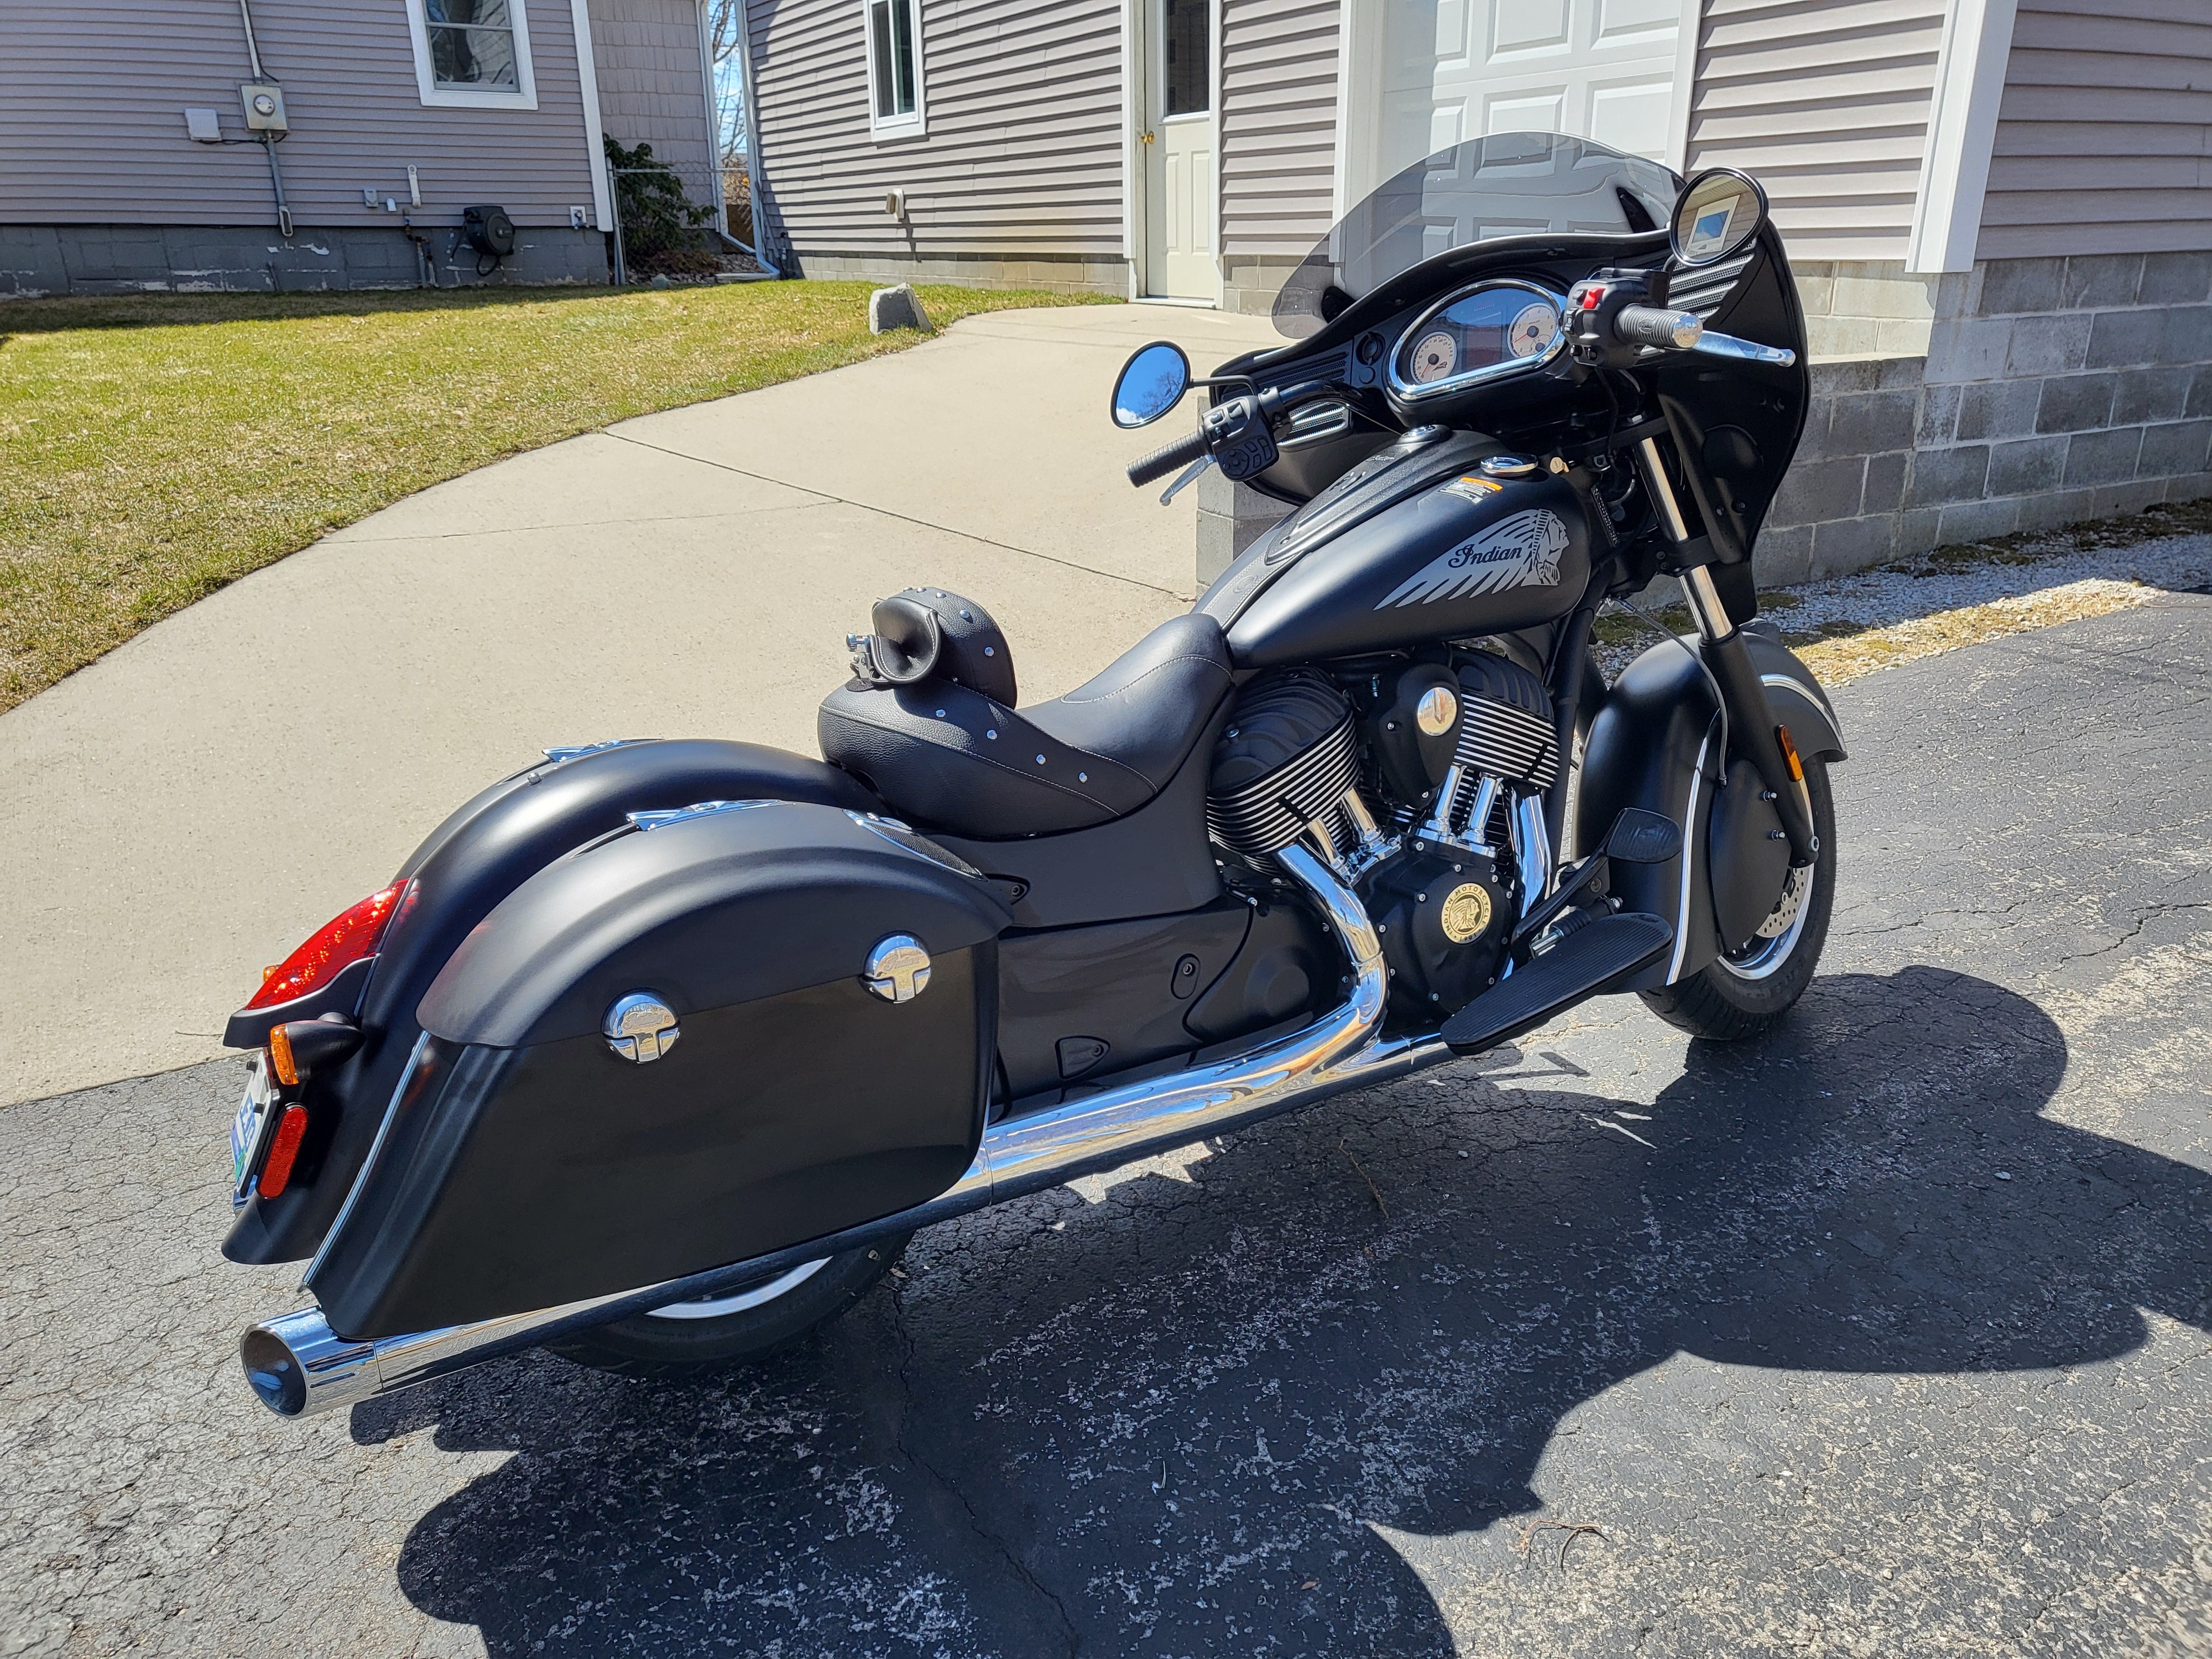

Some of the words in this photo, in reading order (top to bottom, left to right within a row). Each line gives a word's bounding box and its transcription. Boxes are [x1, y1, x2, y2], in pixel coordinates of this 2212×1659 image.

[1448, 544, 1523, 568] Indian
[1444, 898, 1453, 936] INDIAN
[1455, 885, 1489, 925] MOTORCYCLE
[1459, 933, 1477, 941] 1901
